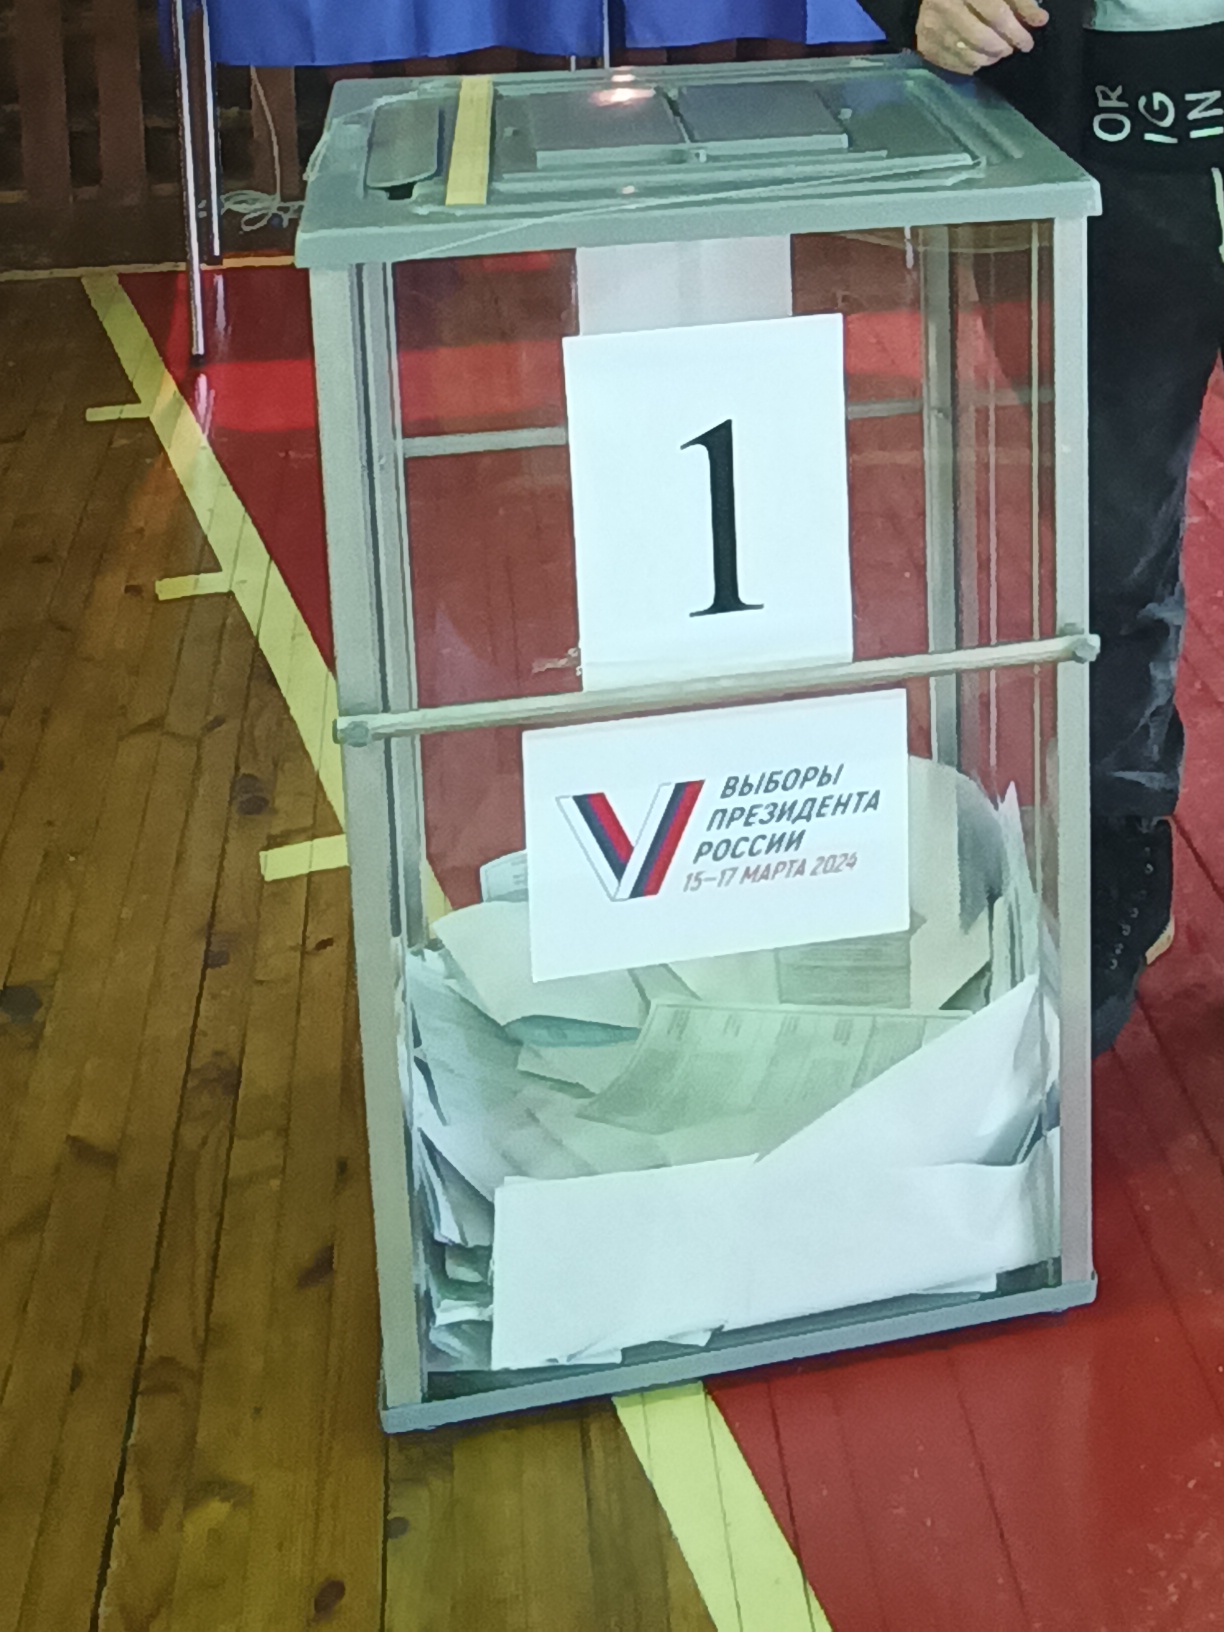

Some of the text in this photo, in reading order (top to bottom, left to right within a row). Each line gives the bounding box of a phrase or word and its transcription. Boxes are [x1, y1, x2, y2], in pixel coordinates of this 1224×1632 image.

[680, 419, 764, 617] 1
[720, 763, 844, 799] ВЫБОРЫ
[706, 789, 881, 832] ПРЕЗИДЕНТА
[692, 829, 807, 864] РОССИИ
[738, 858, 807, 885] МАРТА
[809, 851, 859, 877] 2024
